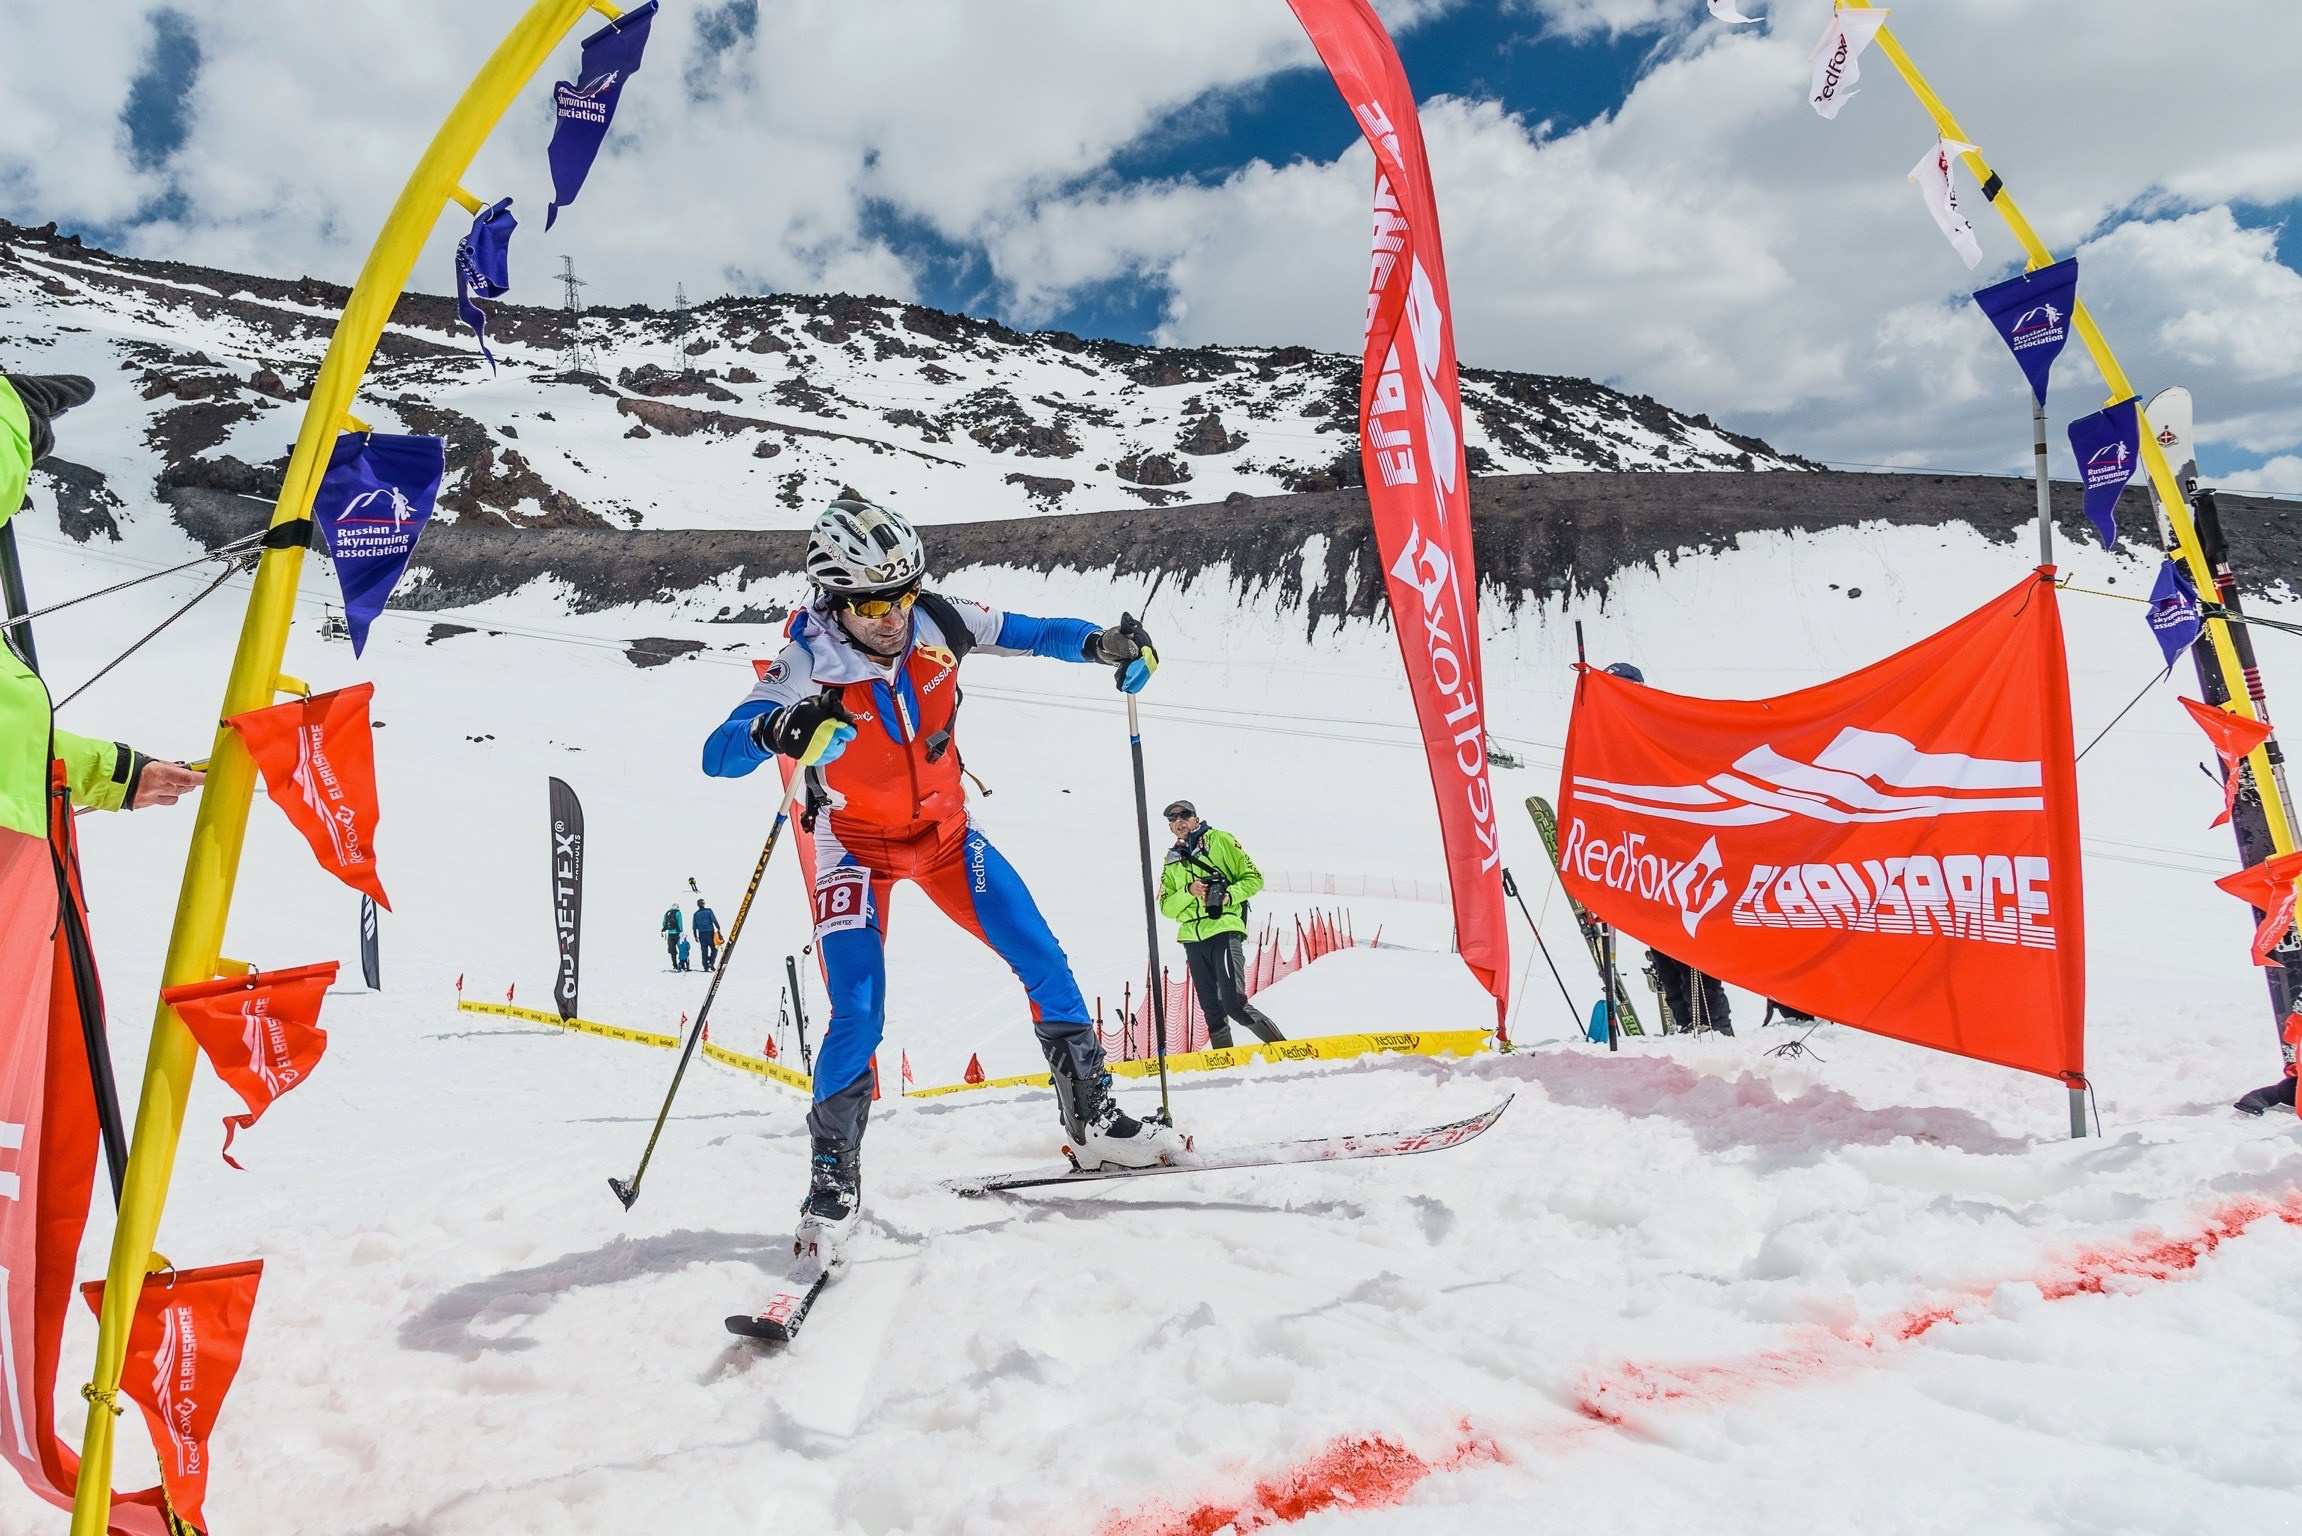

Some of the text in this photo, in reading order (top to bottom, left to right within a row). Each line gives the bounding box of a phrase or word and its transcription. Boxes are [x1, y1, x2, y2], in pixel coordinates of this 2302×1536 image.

[558, 94, 606, 114] skyrunning
[558, 108, 605, 123] association
[2014, 328, 2047, 342] Russian
[2013, 335, 2064, 351] association
[2088, 466, 2116, 476] Russian
[2088, 470, 2130, 483] skyrunning
[337, 526, 390, 538] Russian
[336, 534, 410, 548] skyrunning
[336, 545, 408, 558] association
[881, 558, 910, 582] 23
[2153, 616, 2196, 630] association
[922, 666, 953, 695] RUSSIA
[311, 723, 345, 801] ELBRUSRACE
[972, 849, 986, 893] RedFox
[1560, 817, 1687, 908] RedFox
[1731, 854, 2057, 950] ELBRUSRACE
[817, 886, 852, 920] 18
[254, 996, 293, 1069] ELBRUSCE
[1280, 1044, 1309, 1059] RedFox
[1145, 1060, 1160, 1073] RedFo
[1205, 1053, 1229, 1068] RedFox
[177, 1305, 198, 1392] ELBRUSRACE
[180, 1415, 201, 1475] RedFox
